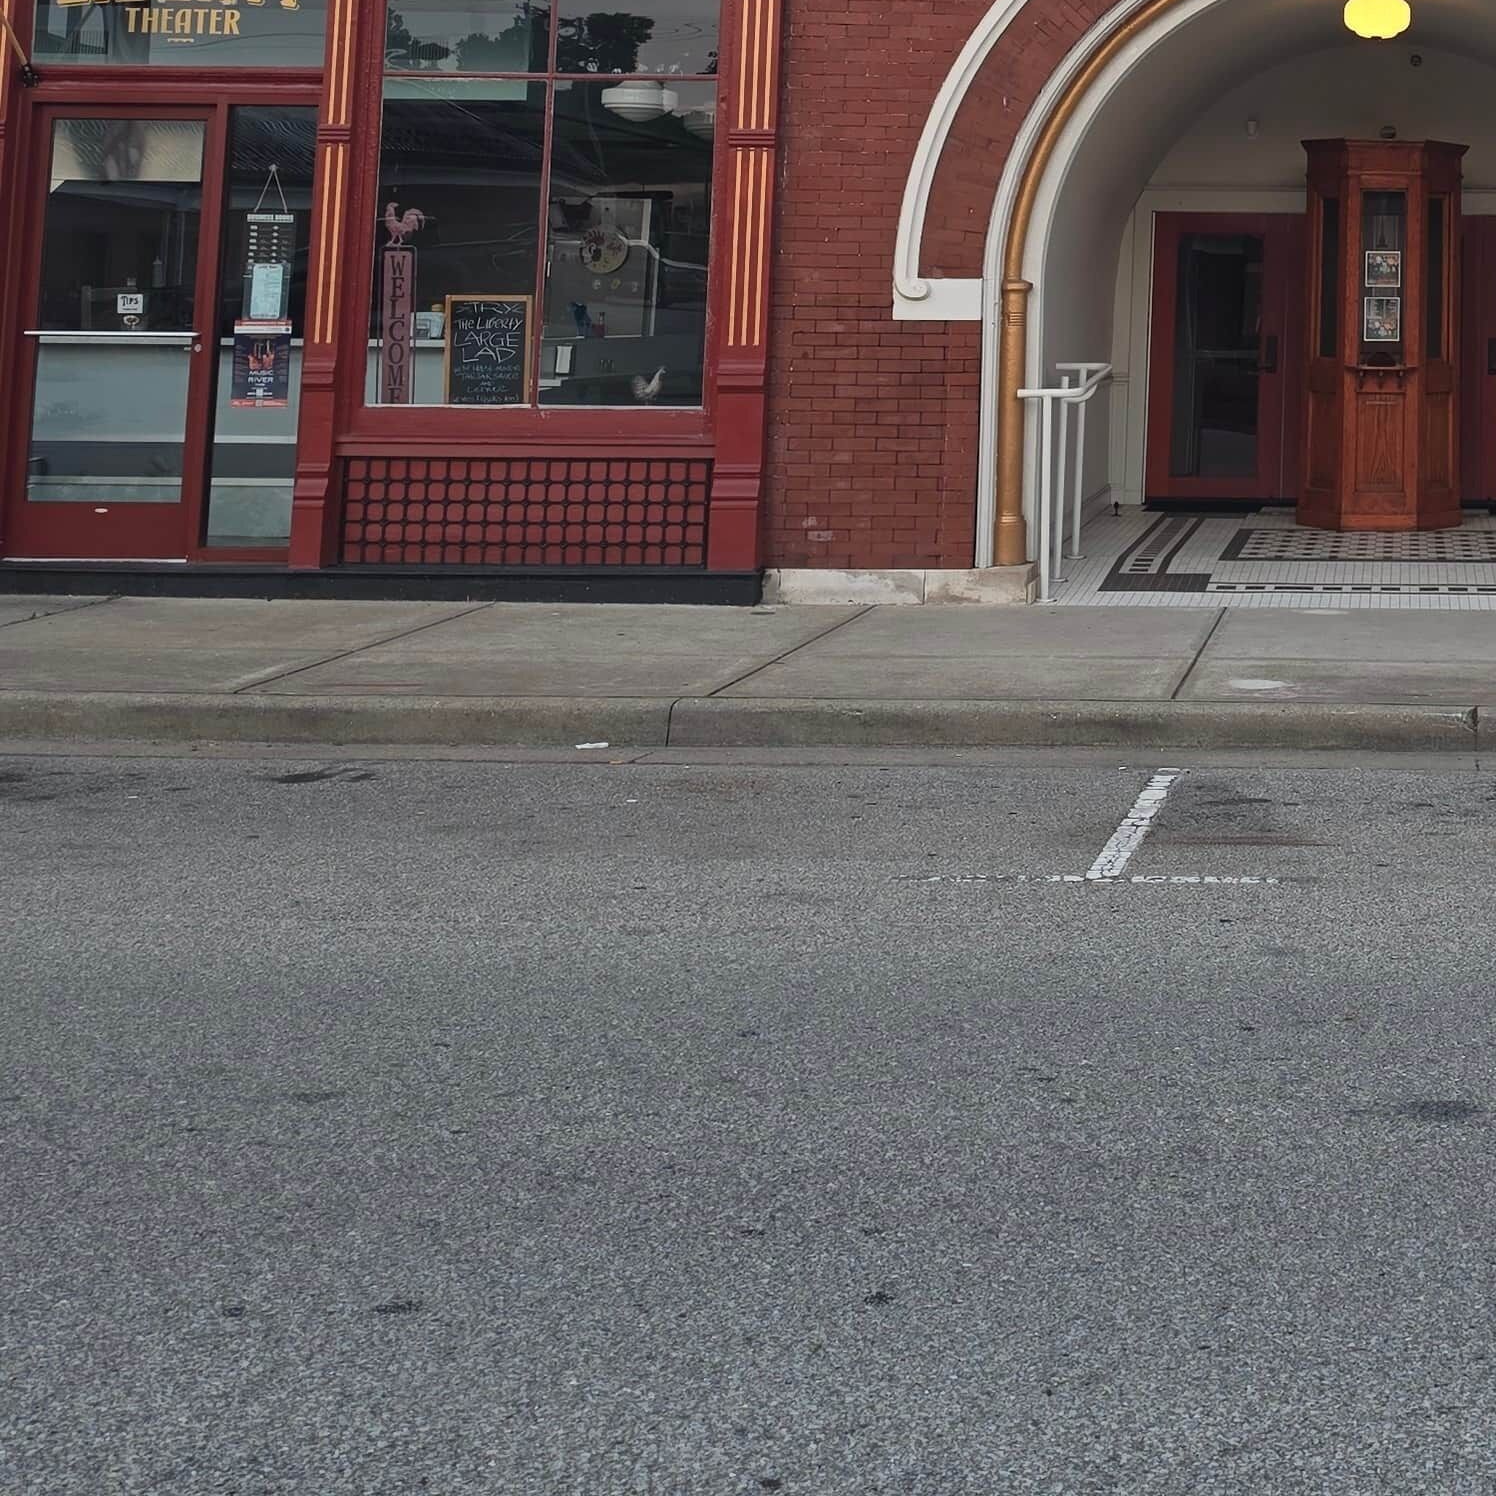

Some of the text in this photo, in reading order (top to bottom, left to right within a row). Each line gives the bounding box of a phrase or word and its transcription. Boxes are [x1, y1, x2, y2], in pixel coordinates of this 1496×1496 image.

[125, 6, 241, 36] THEATER
[388, 255, 405, 404] WELCOME
[454, 330, 521, 348] LARGE
[462, 346, 516, 364] LAD
